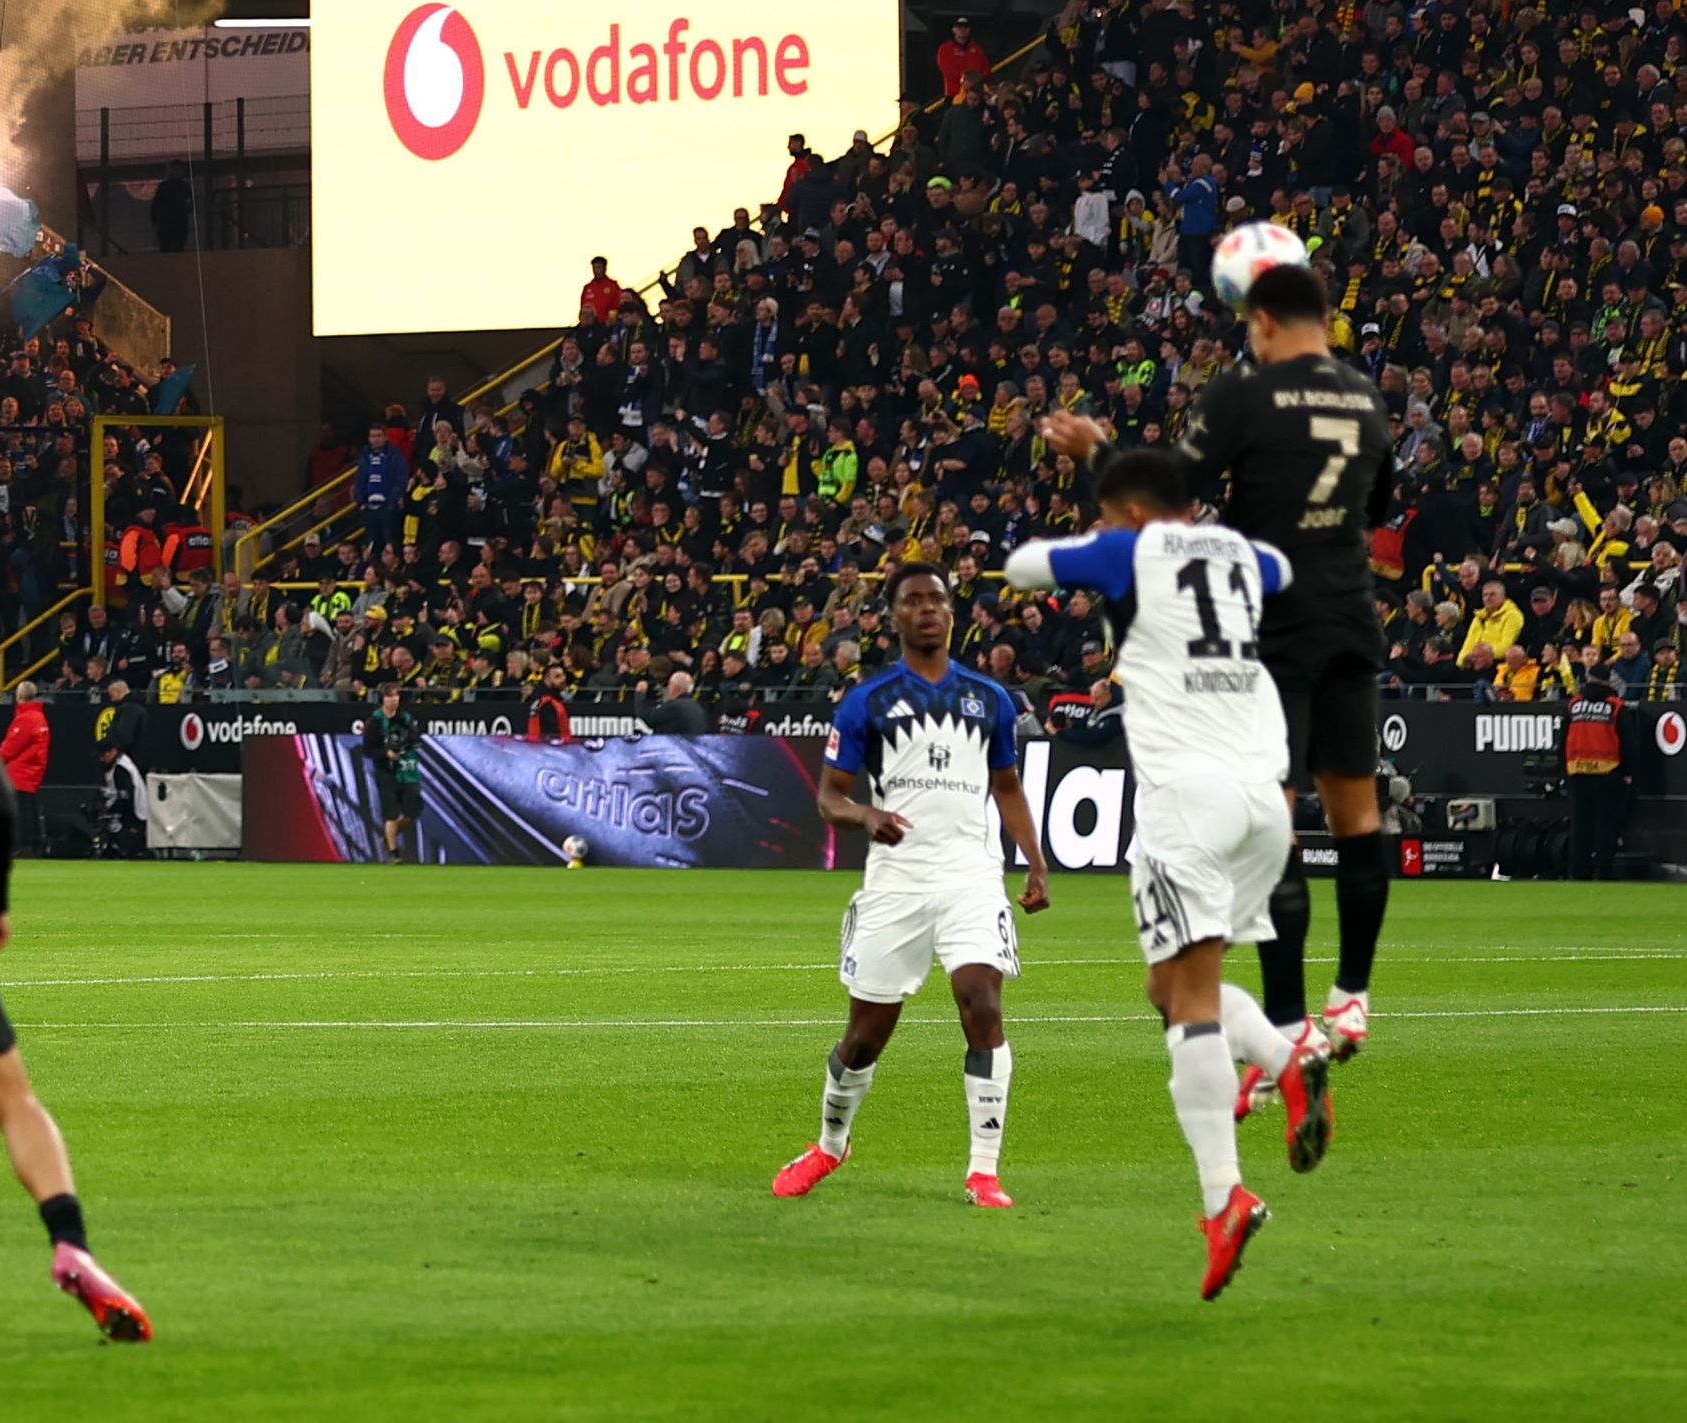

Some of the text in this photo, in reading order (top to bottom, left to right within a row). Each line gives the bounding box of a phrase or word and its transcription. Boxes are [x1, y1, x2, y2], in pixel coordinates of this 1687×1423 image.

[77, 31, 311, 67] ABER ENTSCHEID
[504, 17, 810, 109] vodafone
[1306, 415, 1361, 504] 7
[1177, 558, 1258, 660] 11
[1476, 714, 1554, 752] PUMA
[537, 768, 712, 841] atlas
